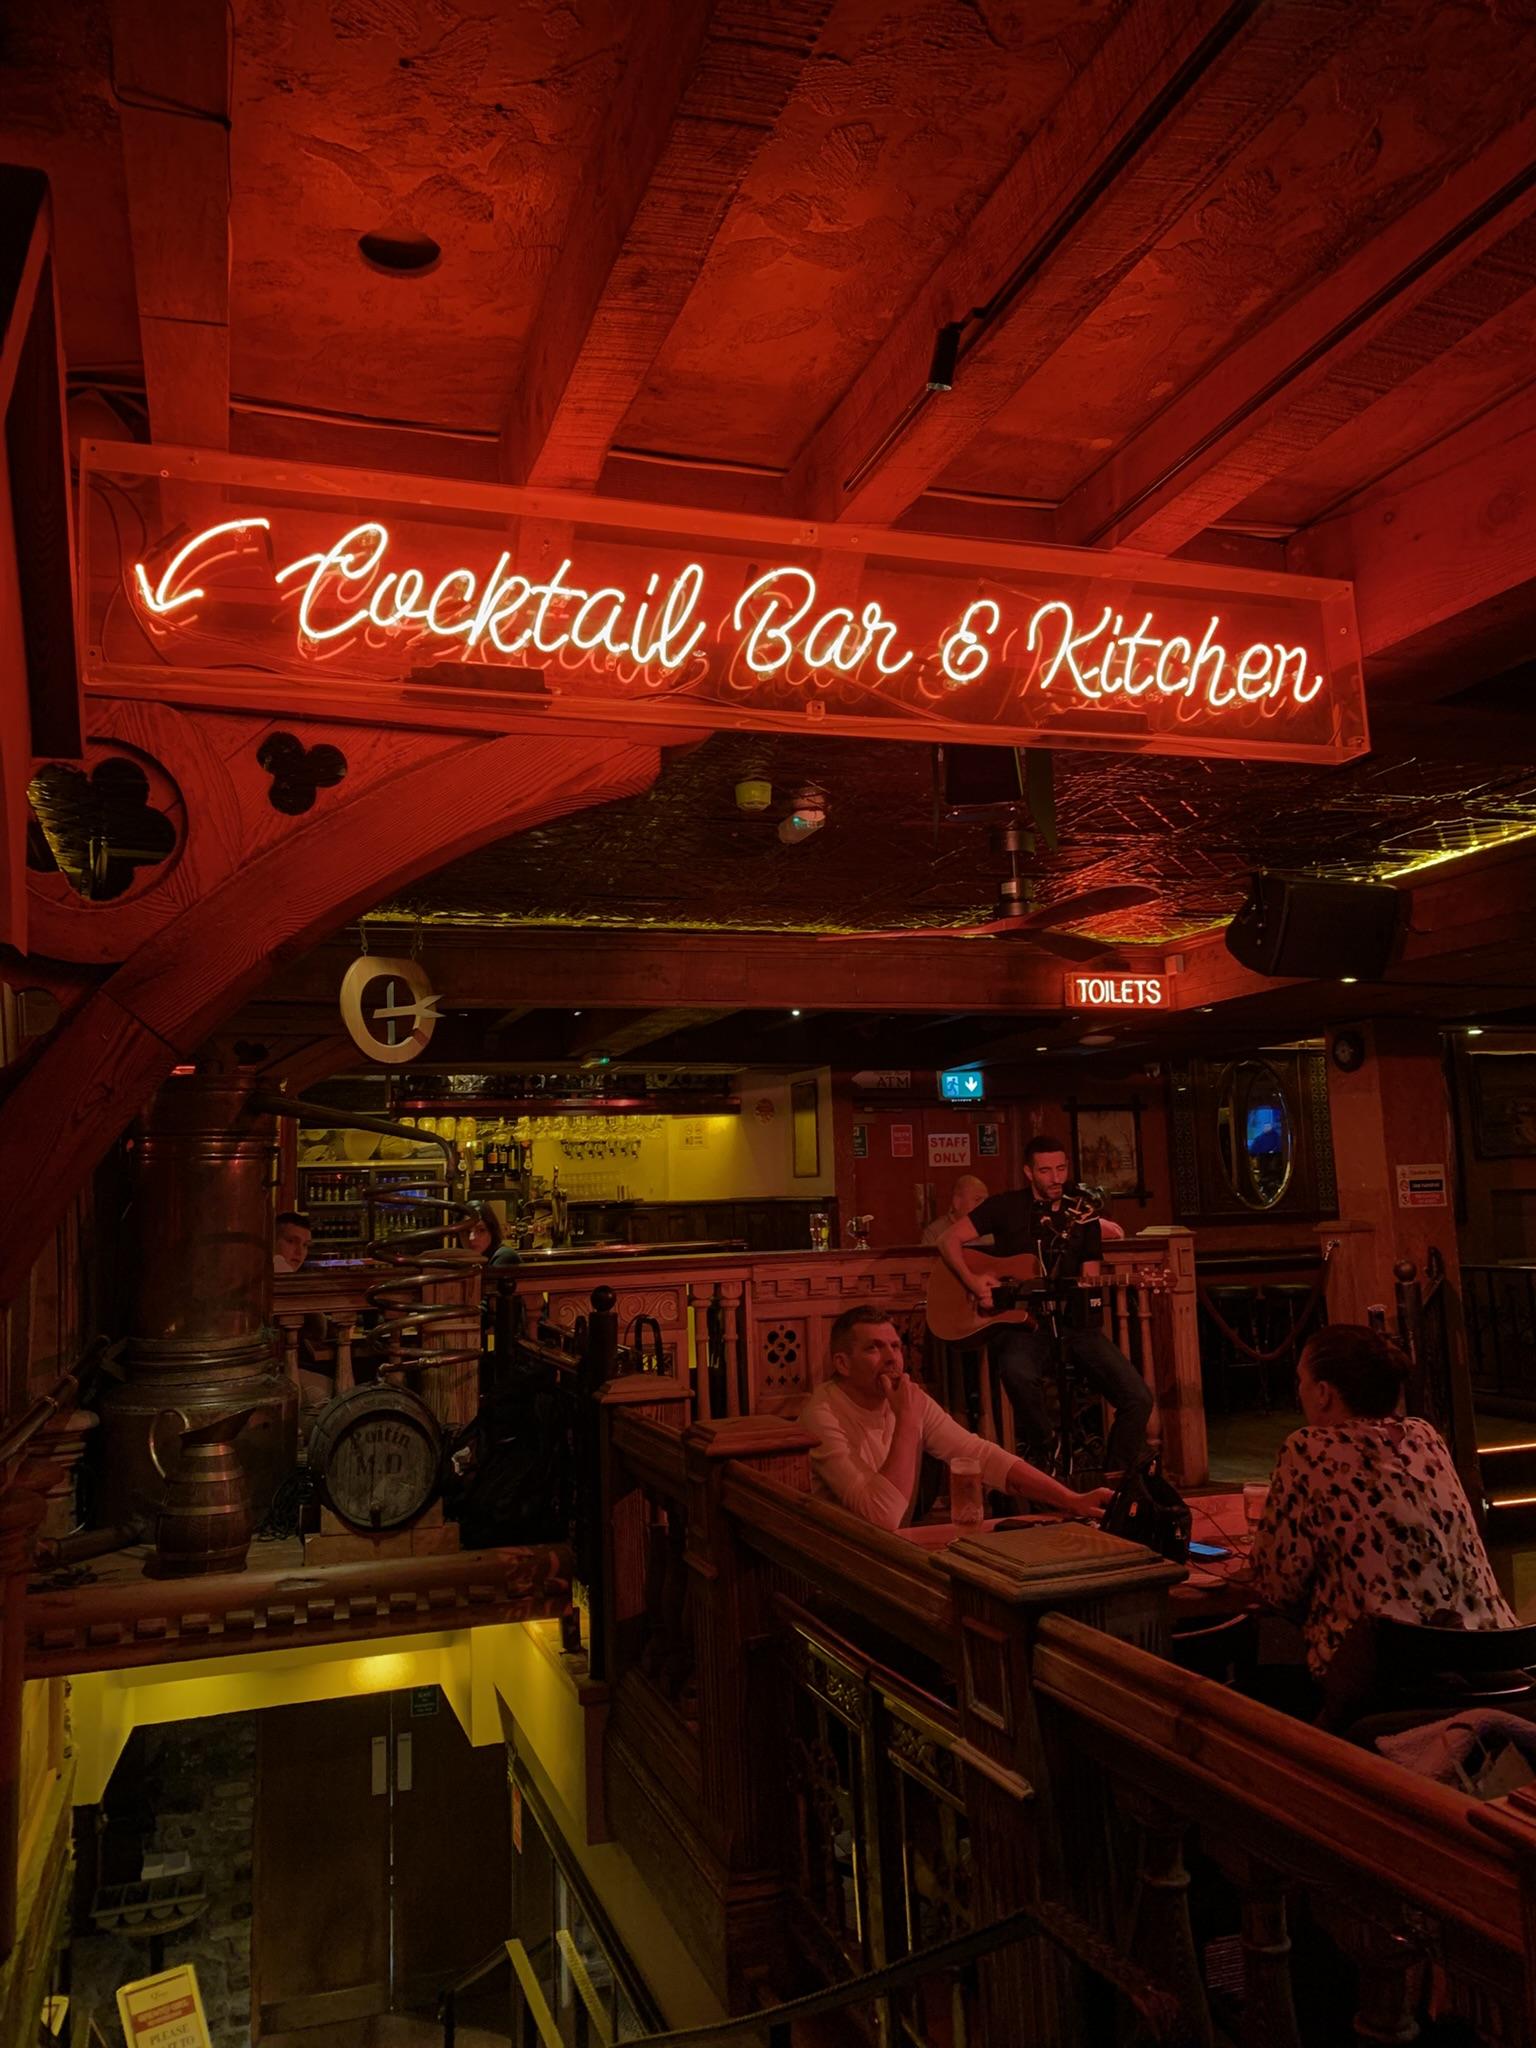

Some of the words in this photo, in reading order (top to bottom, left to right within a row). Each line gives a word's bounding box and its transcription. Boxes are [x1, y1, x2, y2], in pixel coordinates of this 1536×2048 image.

[275, 522, 707, 669] Cocktail
[733, 566, 914, 674] Bar
[940, 599, 1001, 683] &
[1026, 600, 1324, 706] Kitchen
[1076, 978, 1162, 1004] TOILETS
[876, 1076, 909, 1089] ATM
[930, 1137, 968, 1148] STAFF
[934, 1153, 967, 1163] ONLY
[150, 2023, 189, 2046] PLEASE
